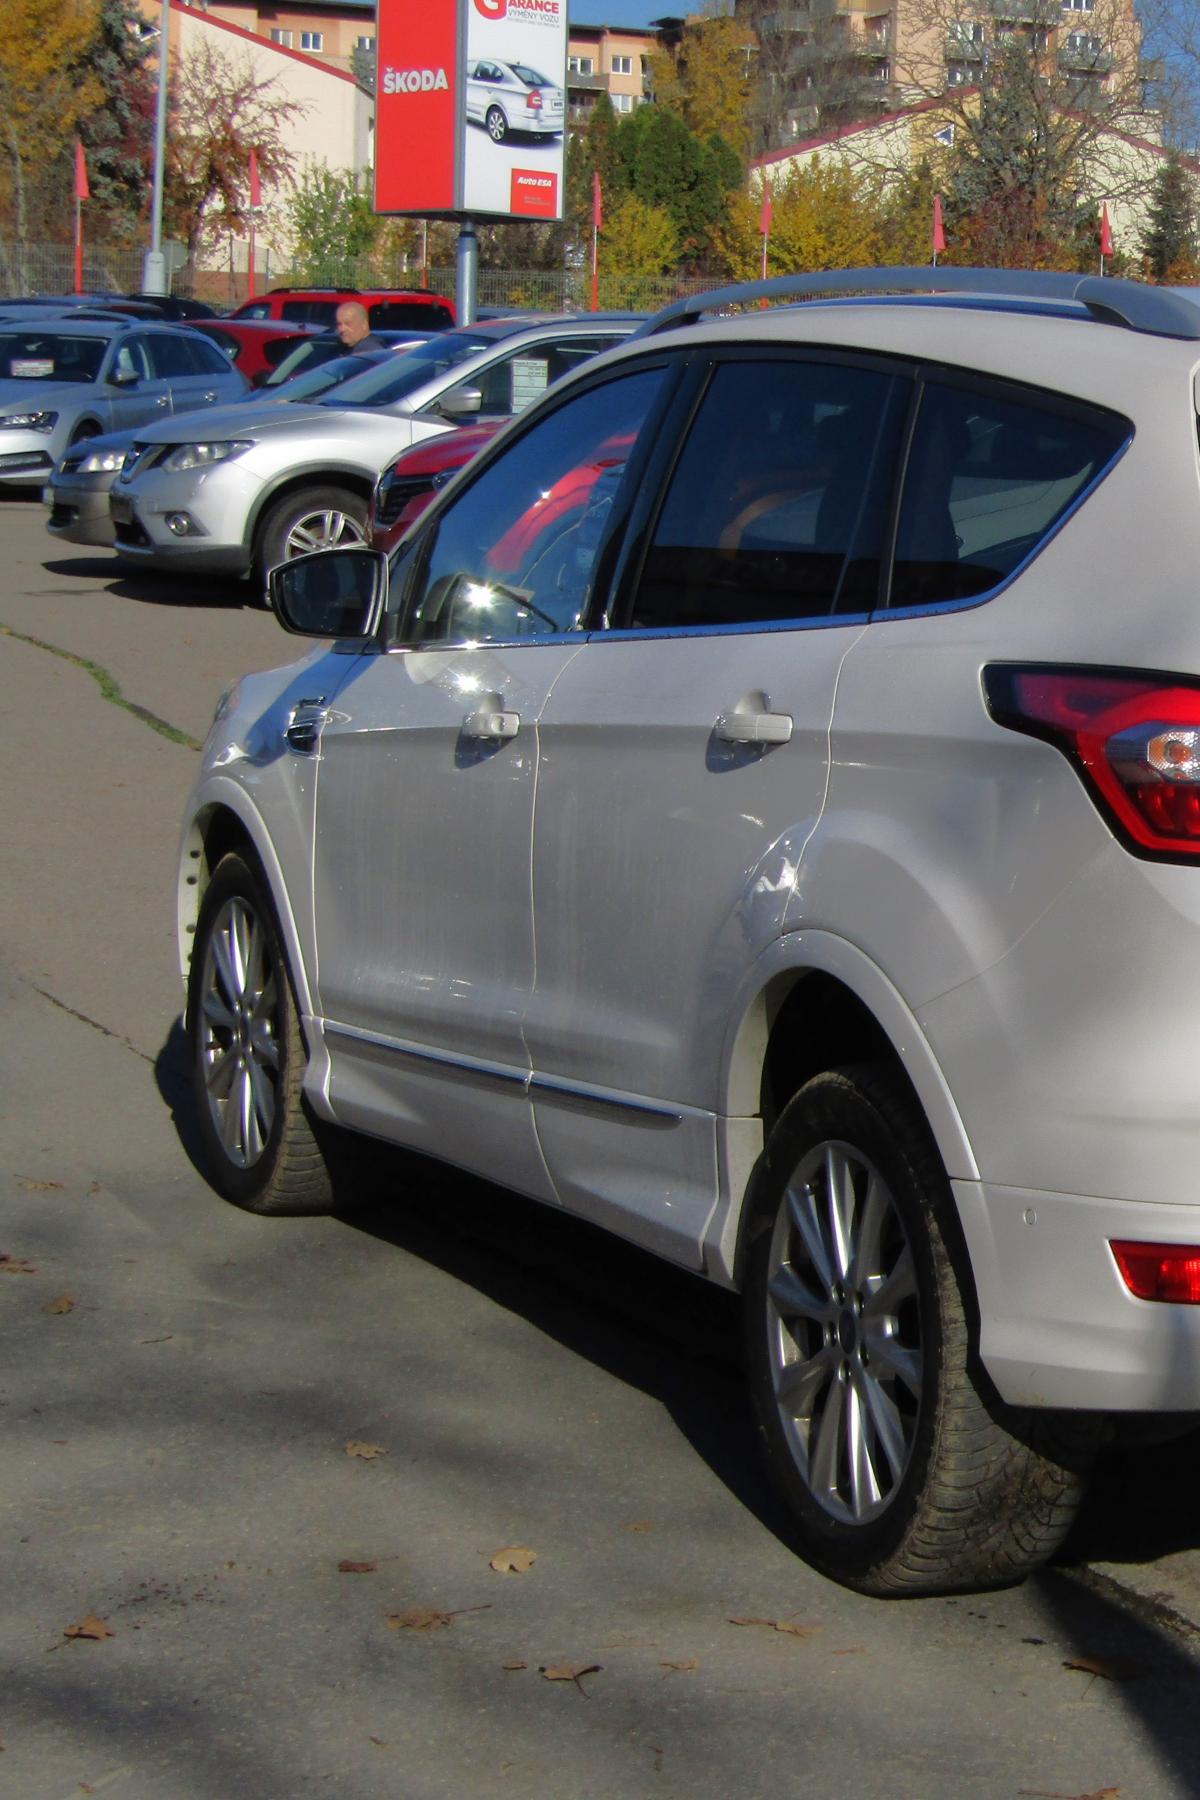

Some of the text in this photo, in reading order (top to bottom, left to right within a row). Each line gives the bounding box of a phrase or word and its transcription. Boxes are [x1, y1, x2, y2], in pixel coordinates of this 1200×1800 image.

[383, 66, 449, 94] ŠKODA
[517, 176, 552, 188] Auto ESA
